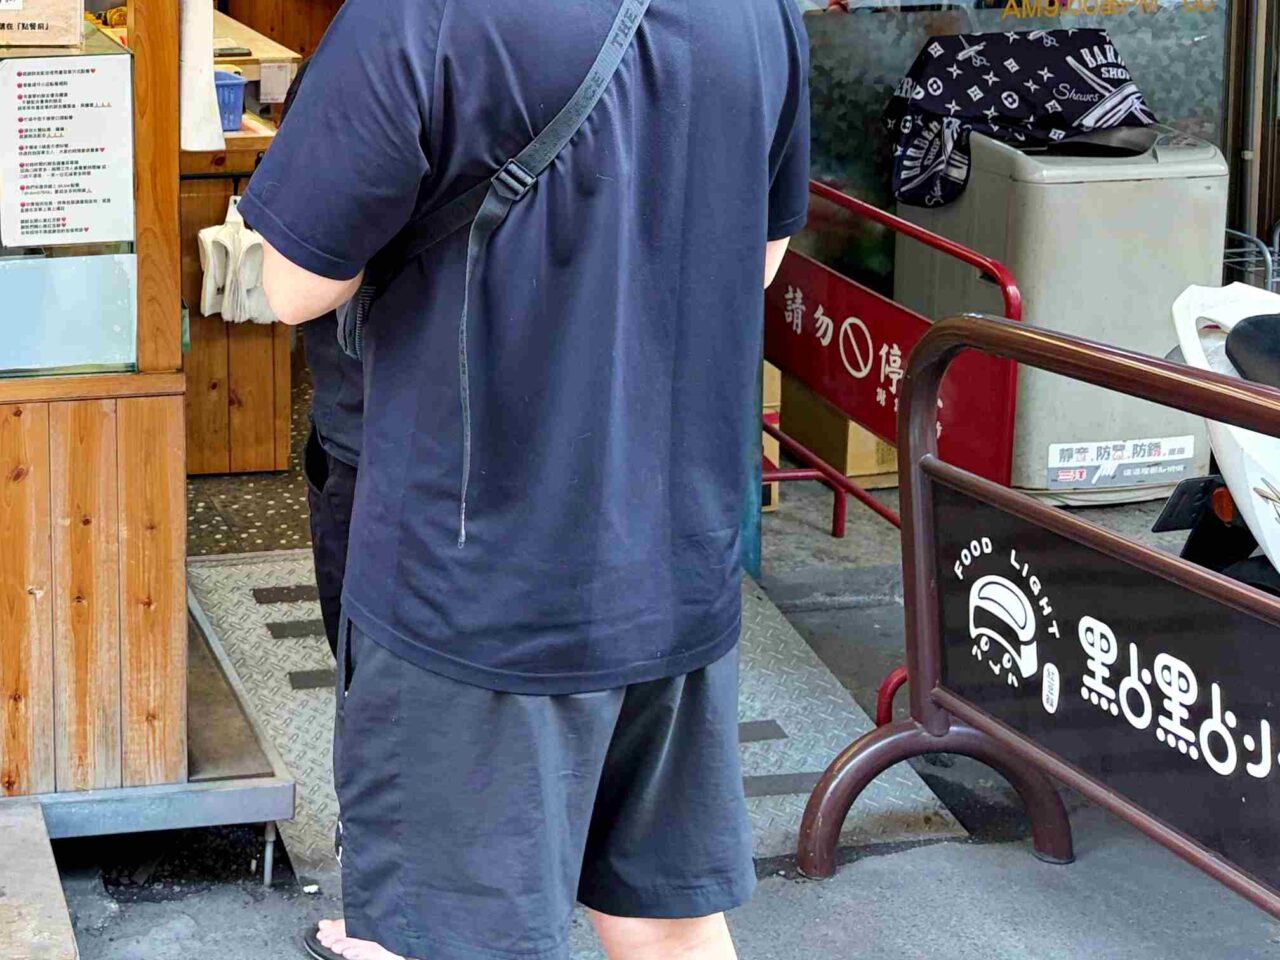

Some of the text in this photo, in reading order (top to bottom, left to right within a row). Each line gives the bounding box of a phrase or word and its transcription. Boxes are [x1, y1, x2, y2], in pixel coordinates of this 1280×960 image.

[611, 8, 638, 48] THE
[954, 536, 1061, 639] FOOD LIGHT
